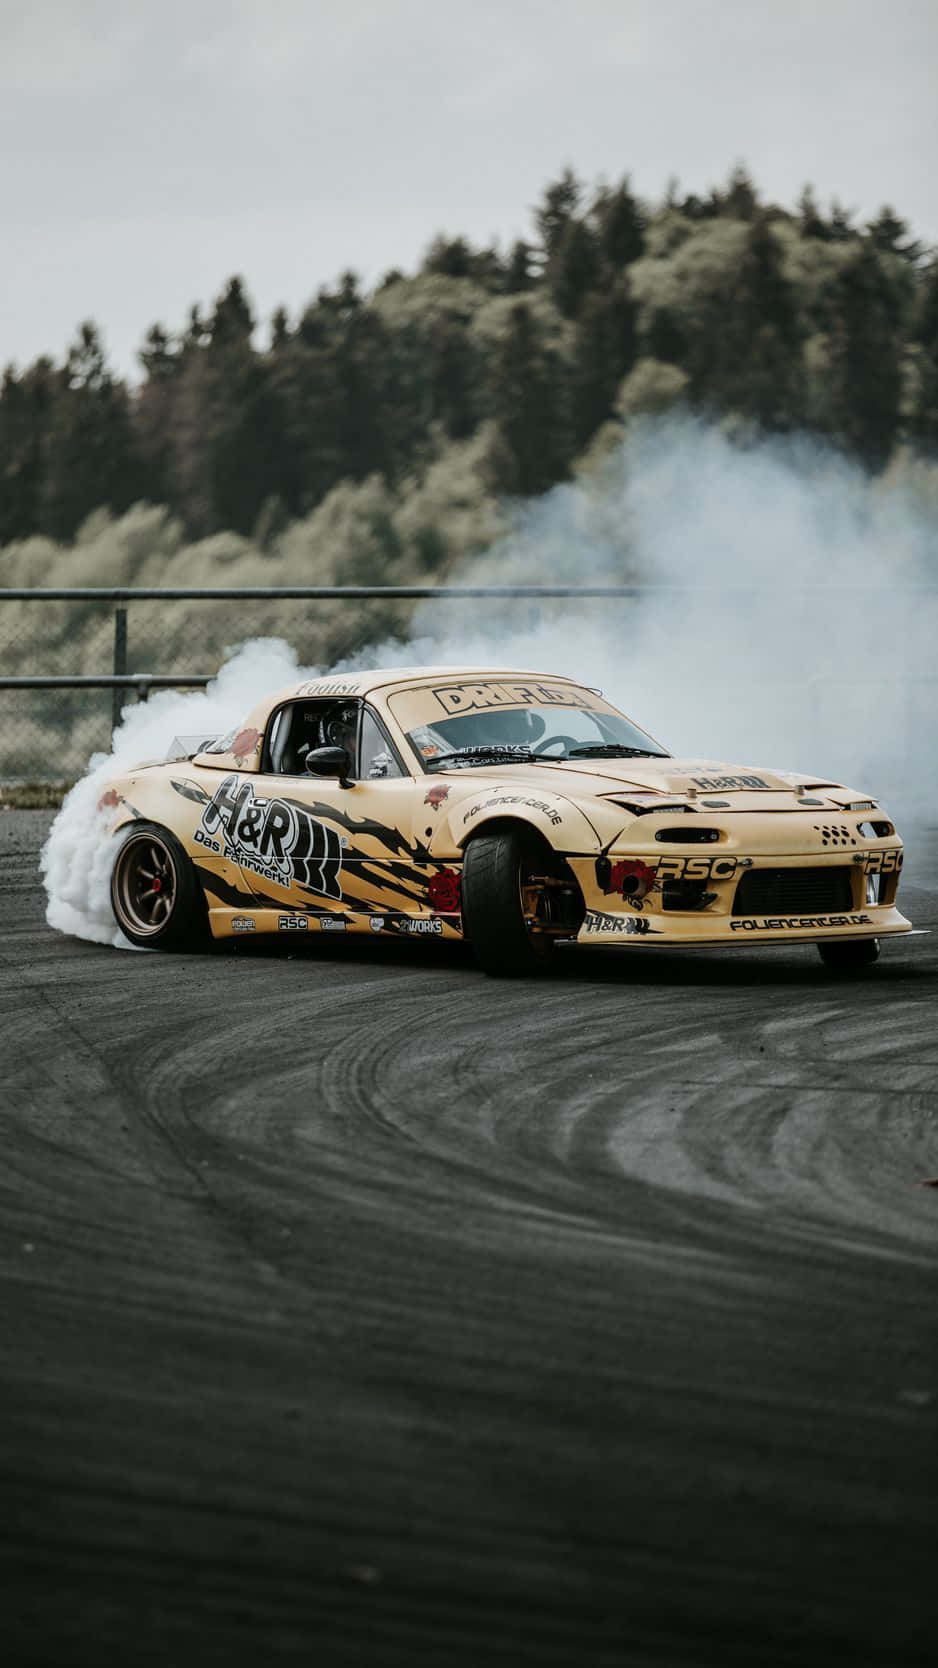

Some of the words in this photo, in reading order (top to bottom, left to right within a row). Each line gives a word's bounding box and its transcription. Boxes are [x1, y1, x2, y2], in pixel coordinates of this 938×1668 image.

[202, 774, 298, 876] H&R
[194, 830, 221, 852] Das
[223, 845, 290, 888] Fahrwerk!
[656, 856, 737, 880] RSC
[279, 916, 308, 930] RSC
[586, 914, 625, 932] H&R
[730, 915, 872, 931] FOLIENCENTER.DE
